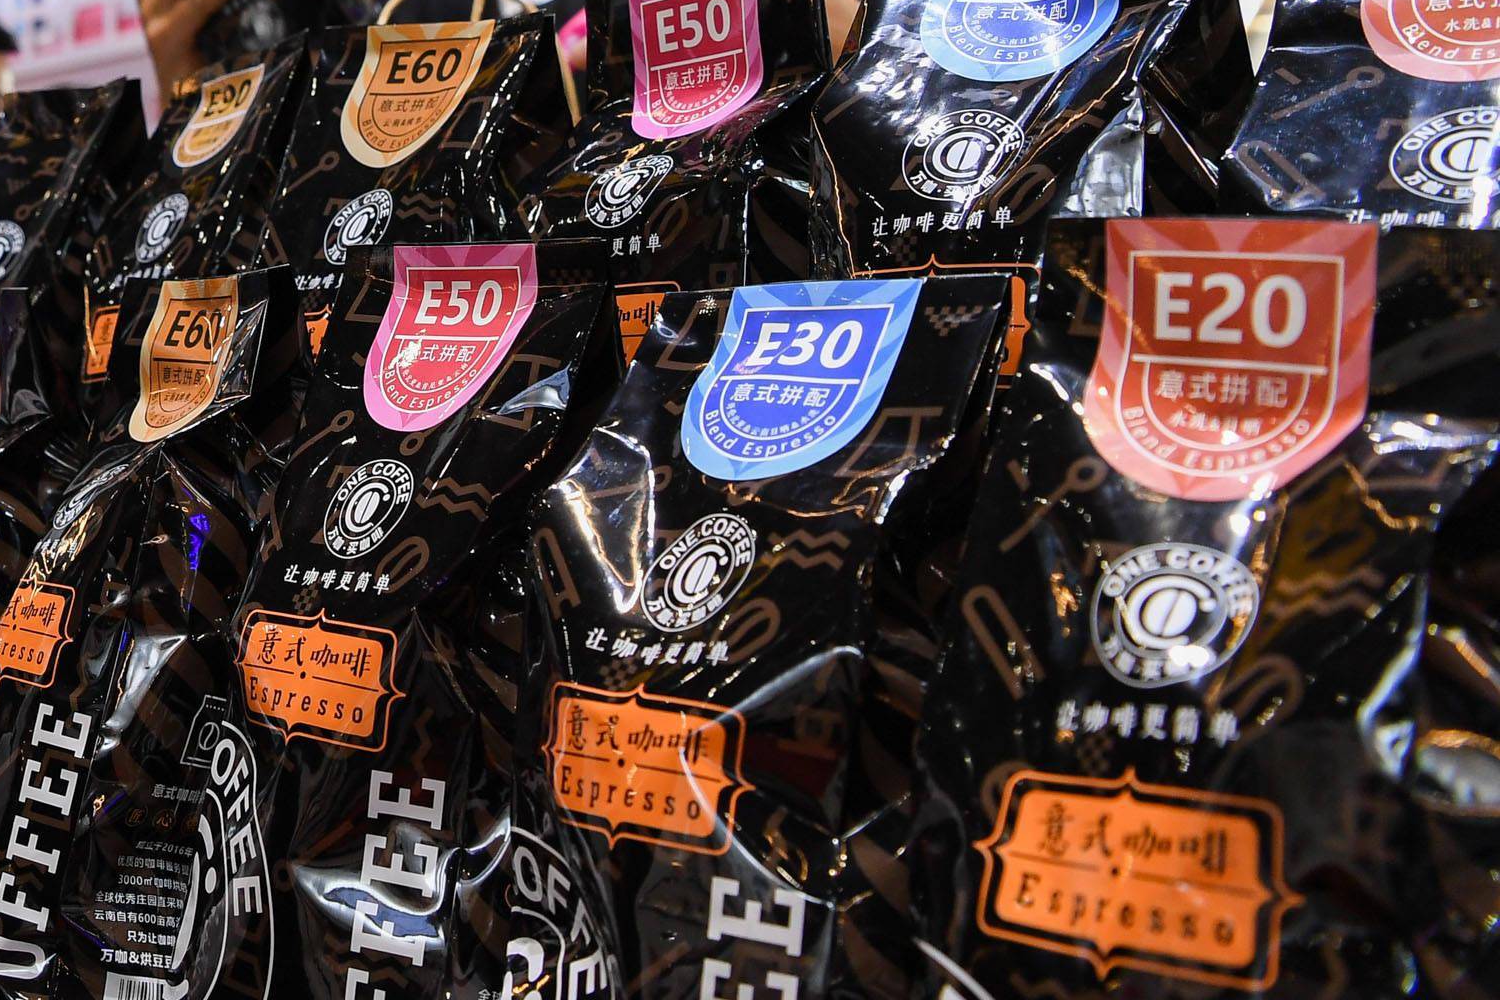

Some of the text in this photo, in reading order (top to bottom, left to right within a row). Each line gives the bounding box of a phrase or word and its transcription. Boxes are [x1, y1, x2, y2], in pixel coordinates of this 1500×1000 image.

[949, 24, 988, 57] Blend
[993, 23, 1083, 63] Esprso
[1402, 23, 1460, 60] Blend
[1444, 16, 1500, 33] 水洗&
[386, 47, 463, 85] E60
[664, 61, 729, 90] 意式拼配
[361, 119, 388, 148] Blend
[959, 112, 1021, 153] COFFEE
[1403, 117, 1452, 151] ONE
[334, 199, 361, 227] ONE
[871, 205, 1015, 238] 让咖啡更简单
[610, 232, 662, 258] 更简单
[414, 278, 503, 327] E50
[1154, 271, 1307, 349] E20
[164, 308, 221, 350] E60
[745, 320, 864, 369] E30
[402, 343, 477, 363] 式拼配
[384, 369, 408, 405] Blend
[408, 369, 477, 411] Espresso
[729, 382, 831, 408] 意式拼配
[1155, 369, 1288, 408] 意式拼配
[705, 409, 739, 450] Blend
[741, 415, 837, 458] Espresso
[1123, 406, 1311, 472] Blend Espresso
[337, 461, 411, 505] ONE COFFEE
[658, 517, 751, 571] ONE COFFEE
[283, 564, 391, 596] 让咖啡更简单
[1103, 549, 1161, 598] ONE
[256, 628, 373, 679] 意式咖啡
[585, 628, 730, 666] 让咖啡更简单
[248, 675, 364, 725] Espresso
[565, 704, 710, 766] 意式咖啡
[560, 764, 701, 821] Espresso
[210, 738, 264, 917] OFFEE
[1039, 802, 1229, 879] 意式咖啡
[1015, 872, 1236, 948] Espresso
